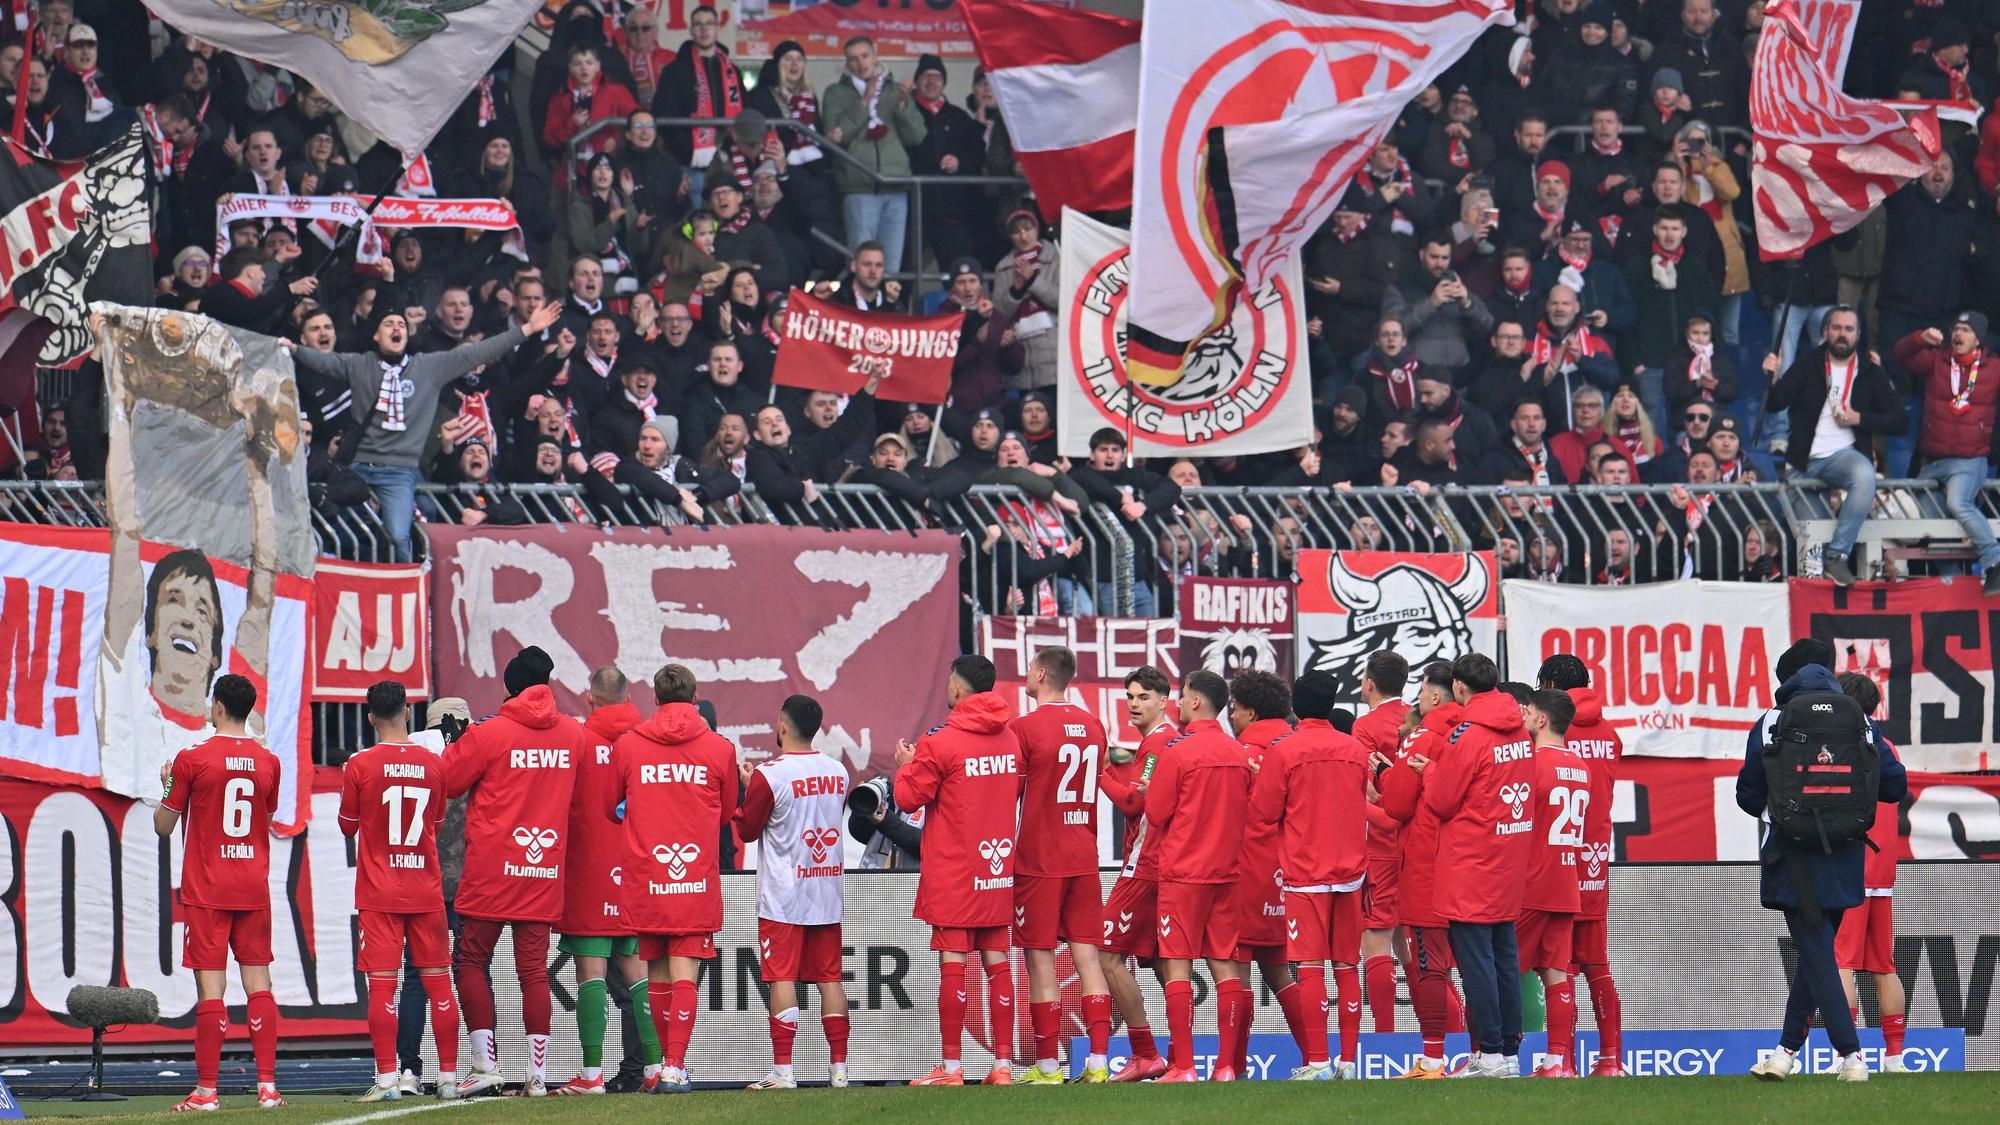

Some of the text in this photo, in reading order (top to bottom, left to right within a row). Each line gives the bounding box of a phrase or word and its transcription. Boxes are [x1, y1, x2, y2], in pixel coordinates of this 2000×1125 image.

[787, 310, 961, 359] HÖHER JUNGS
[848, 354, 893, 378] 203
[1182, 350, 1287, 443] KÖLN
[1193, 583, 1288, 623] RAFIKIS
[324, 592, 416, 673] AJJ
[1063, 723, 1087, 738] TIGGES
[1640, 711, 1685, 730] KÖLN
[510, 748, 571, 769] REWE
[1493, 740, 1533, 764] REWE
[1567, 739, 1615, 760] REWE
[226, 757, 256, 771] MARTEL
[384, 763, 425, 779] PACARADA
[640, 763, 708, 785] REWE
[964, 753, 1017, 777] REWE
[1056, 743, 1099, 803] 21
[1142, 755, 1155, 780] DEVK
[1555, 767, 1588, 783] THIELMANN
[164, 776, 173, 798] DEVK
[791, 775, 844, 799] REWE
[222, 777, 255, 837] 6
[382, 785, 431, 847] 17
[1548, 786, 1590, 848] 29
[503, 861, 559, 879] hummel
[797, 862, 843, 879] hummel
[649, 878, 707, 895] hummel
[973, 876, 1014, 891] humme
